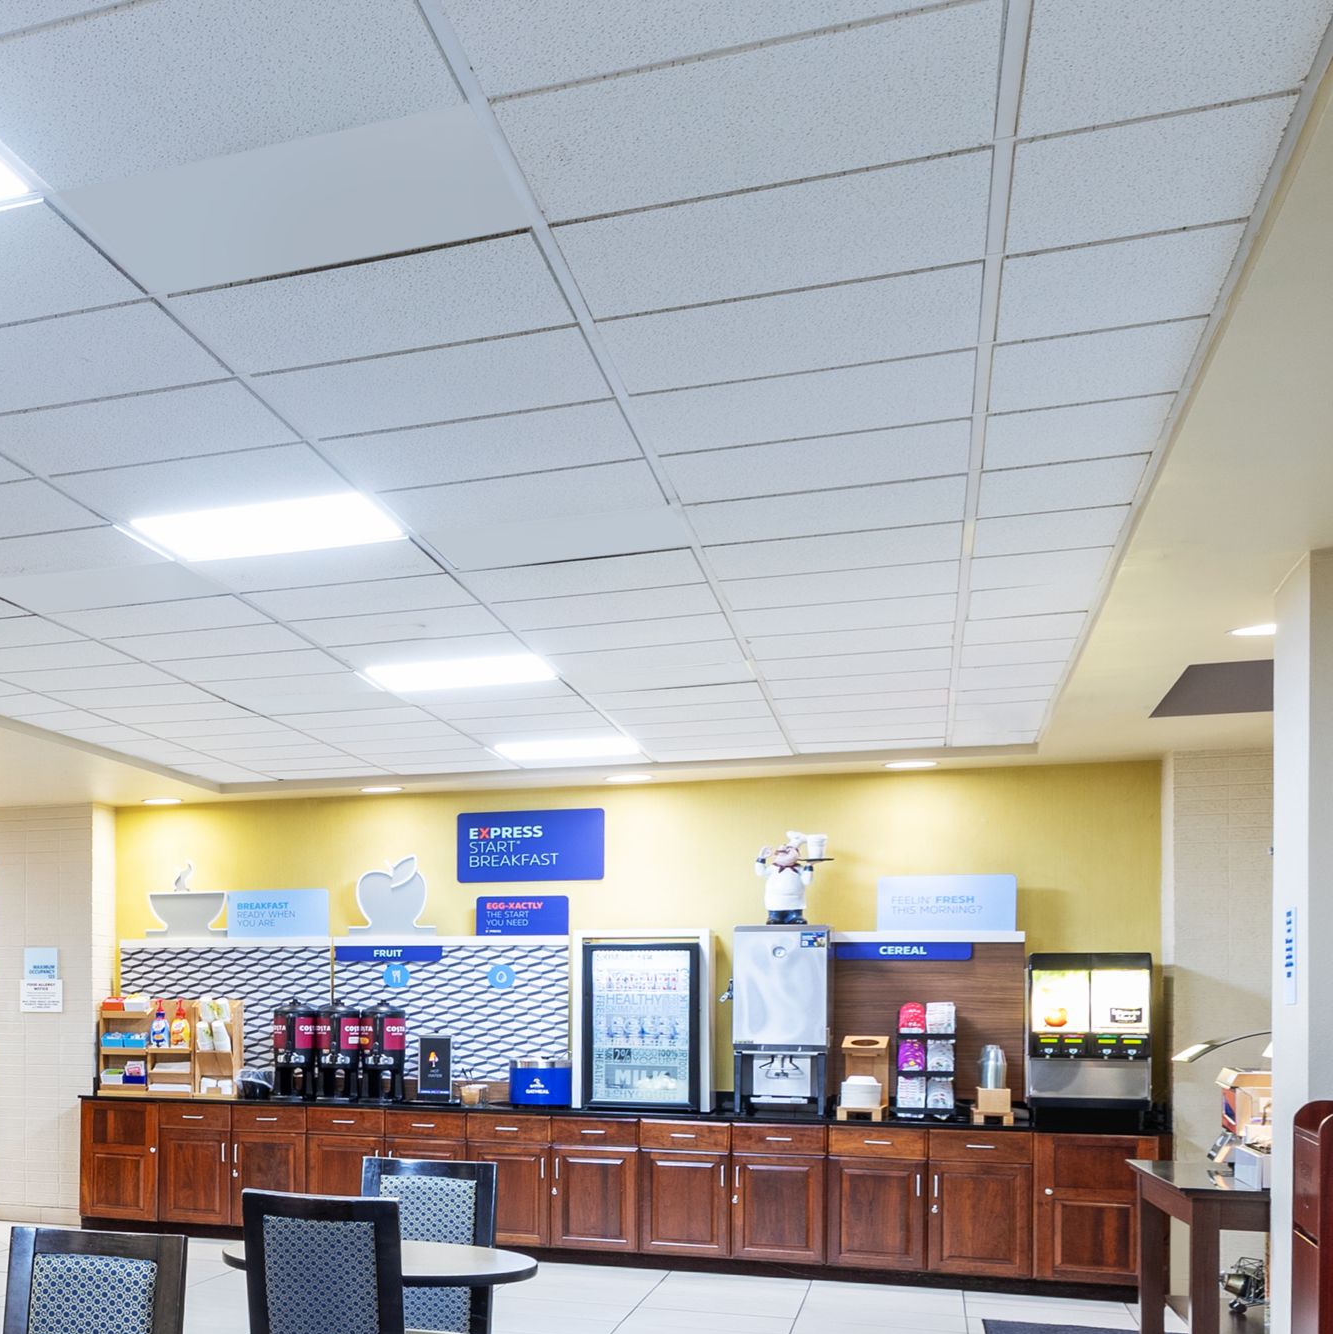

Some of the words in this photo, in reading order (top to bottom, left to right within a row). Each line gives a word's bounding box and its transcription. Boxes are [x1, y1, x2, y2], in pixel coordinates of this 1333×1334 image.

[469, 826, 543, 840] EXPRESS
[469, 853, 559, 868] BREAKFAST
[935, 895, 975, 904] FRESH
[237, 902, 289, 910] BREAKFAST
[486, 902, 543, 910] EGG-XACTLY
[892, 906, 916, 915] THIS
[920, 905, 983, 914] MORNING?
[237, 911, 265, 919] READY
[268, 910, 296, 918] WHEN
[486, 911, 502, 919] THE
[504, 910, 529, 918] START
[237, 919, 256, 928] YOU
[258, 919, 275, 927] ARE
[486, 919, 504, 927] YOU
[373, 949, 402, 958] FRUIT
[879, 946, 927, 955] CEREAL
[606, 993, 661, 1005] HEALTHY
